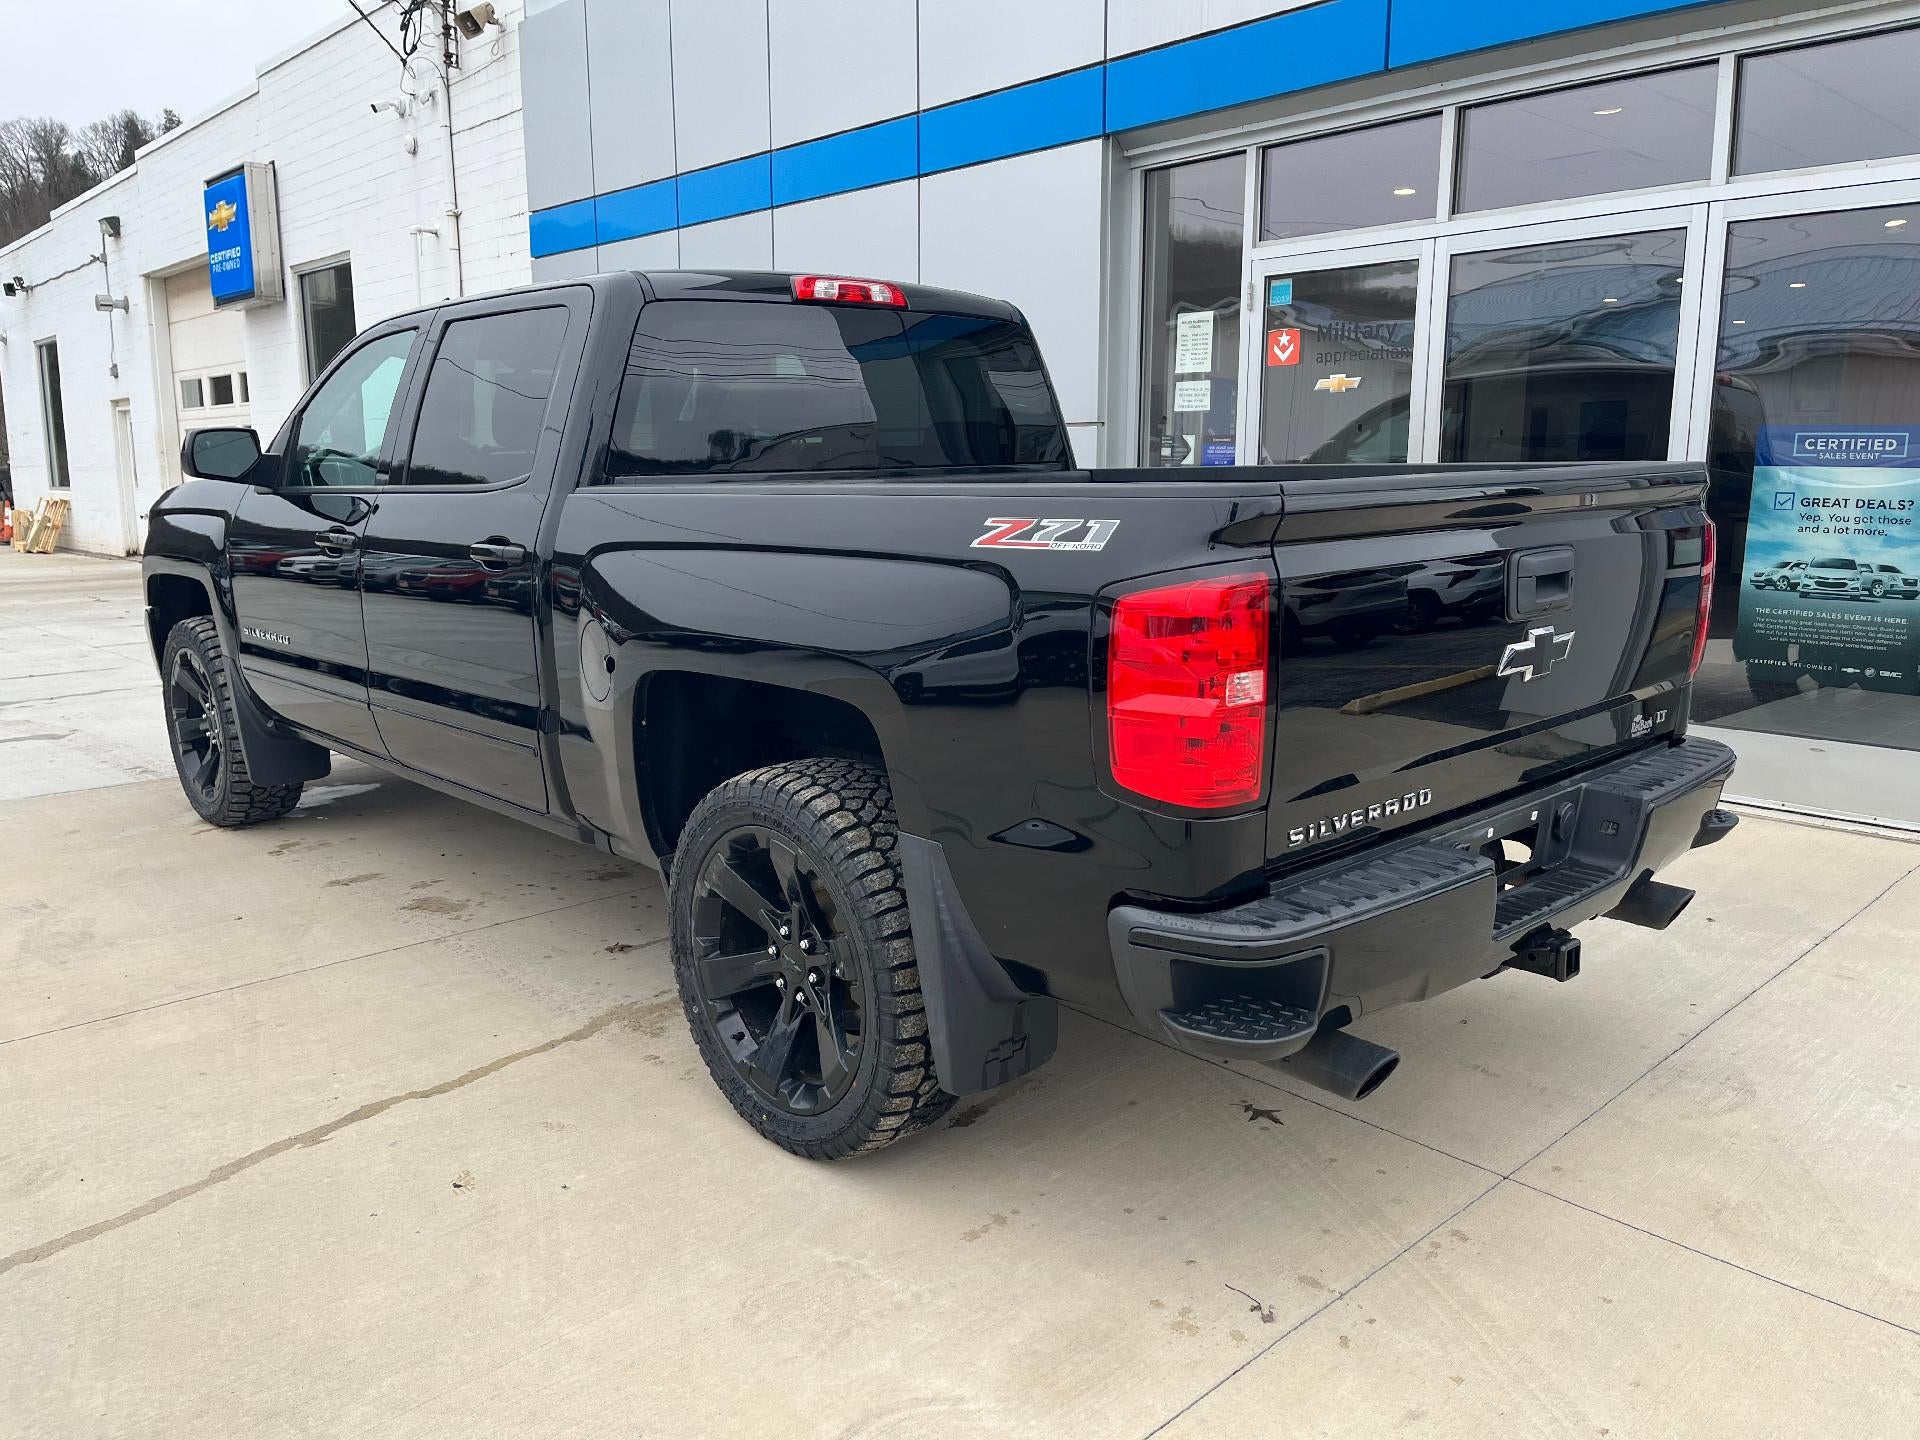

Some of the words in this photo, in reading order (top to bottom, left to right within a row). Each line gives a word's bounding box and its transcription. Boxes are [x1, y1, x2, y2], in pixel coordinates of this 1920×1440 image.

[210, 246, 241, 265] CERTIFIED
[212, 258, 240, 274] PRE-OWNED
[1317, 321, 1398, 343] Military
[1315, 345, 1410, 366] appreciation
[1804, 438, 1898, 451] CERTIFIED
[1818, 452, 1847, 460] SALES
[1849, 452, 1880, 460] EVENT
[1800, 497, 1850, 508] GREAT
[1855, 499, 1915, 511] DEALS?
[1799, 512, 1823, 523] Yep.
[1828, 513, 1850, 523] You
[1878, 515, 1912, 526] those
[969, 517, 1121, 550] Z71
[1797, 525, 1820, 533] and
[1822, 526, 1830, 534] a
[1833, 525, 1849, 535] lot
[1853, 528, 1888, 537] more.
[1050, 542, 1070, 550] OFF
[1772, 608, 1814, 617] CERTIFIED
[1816, 611, 1842, 619] SALES
[1844, 613, 1872, 622] EVENT
[1884, 617, 1909, 625] HERE.
[243, 627, 290, 645] SILVERADO
[1749, 658, 1787, 667] CERTIFIED
[1789, 661, 1833, 671] PRE-OWNED
[1879, 670, 1902, 679] GMC
[1287, 788, 1432, 848] SILVERADO
